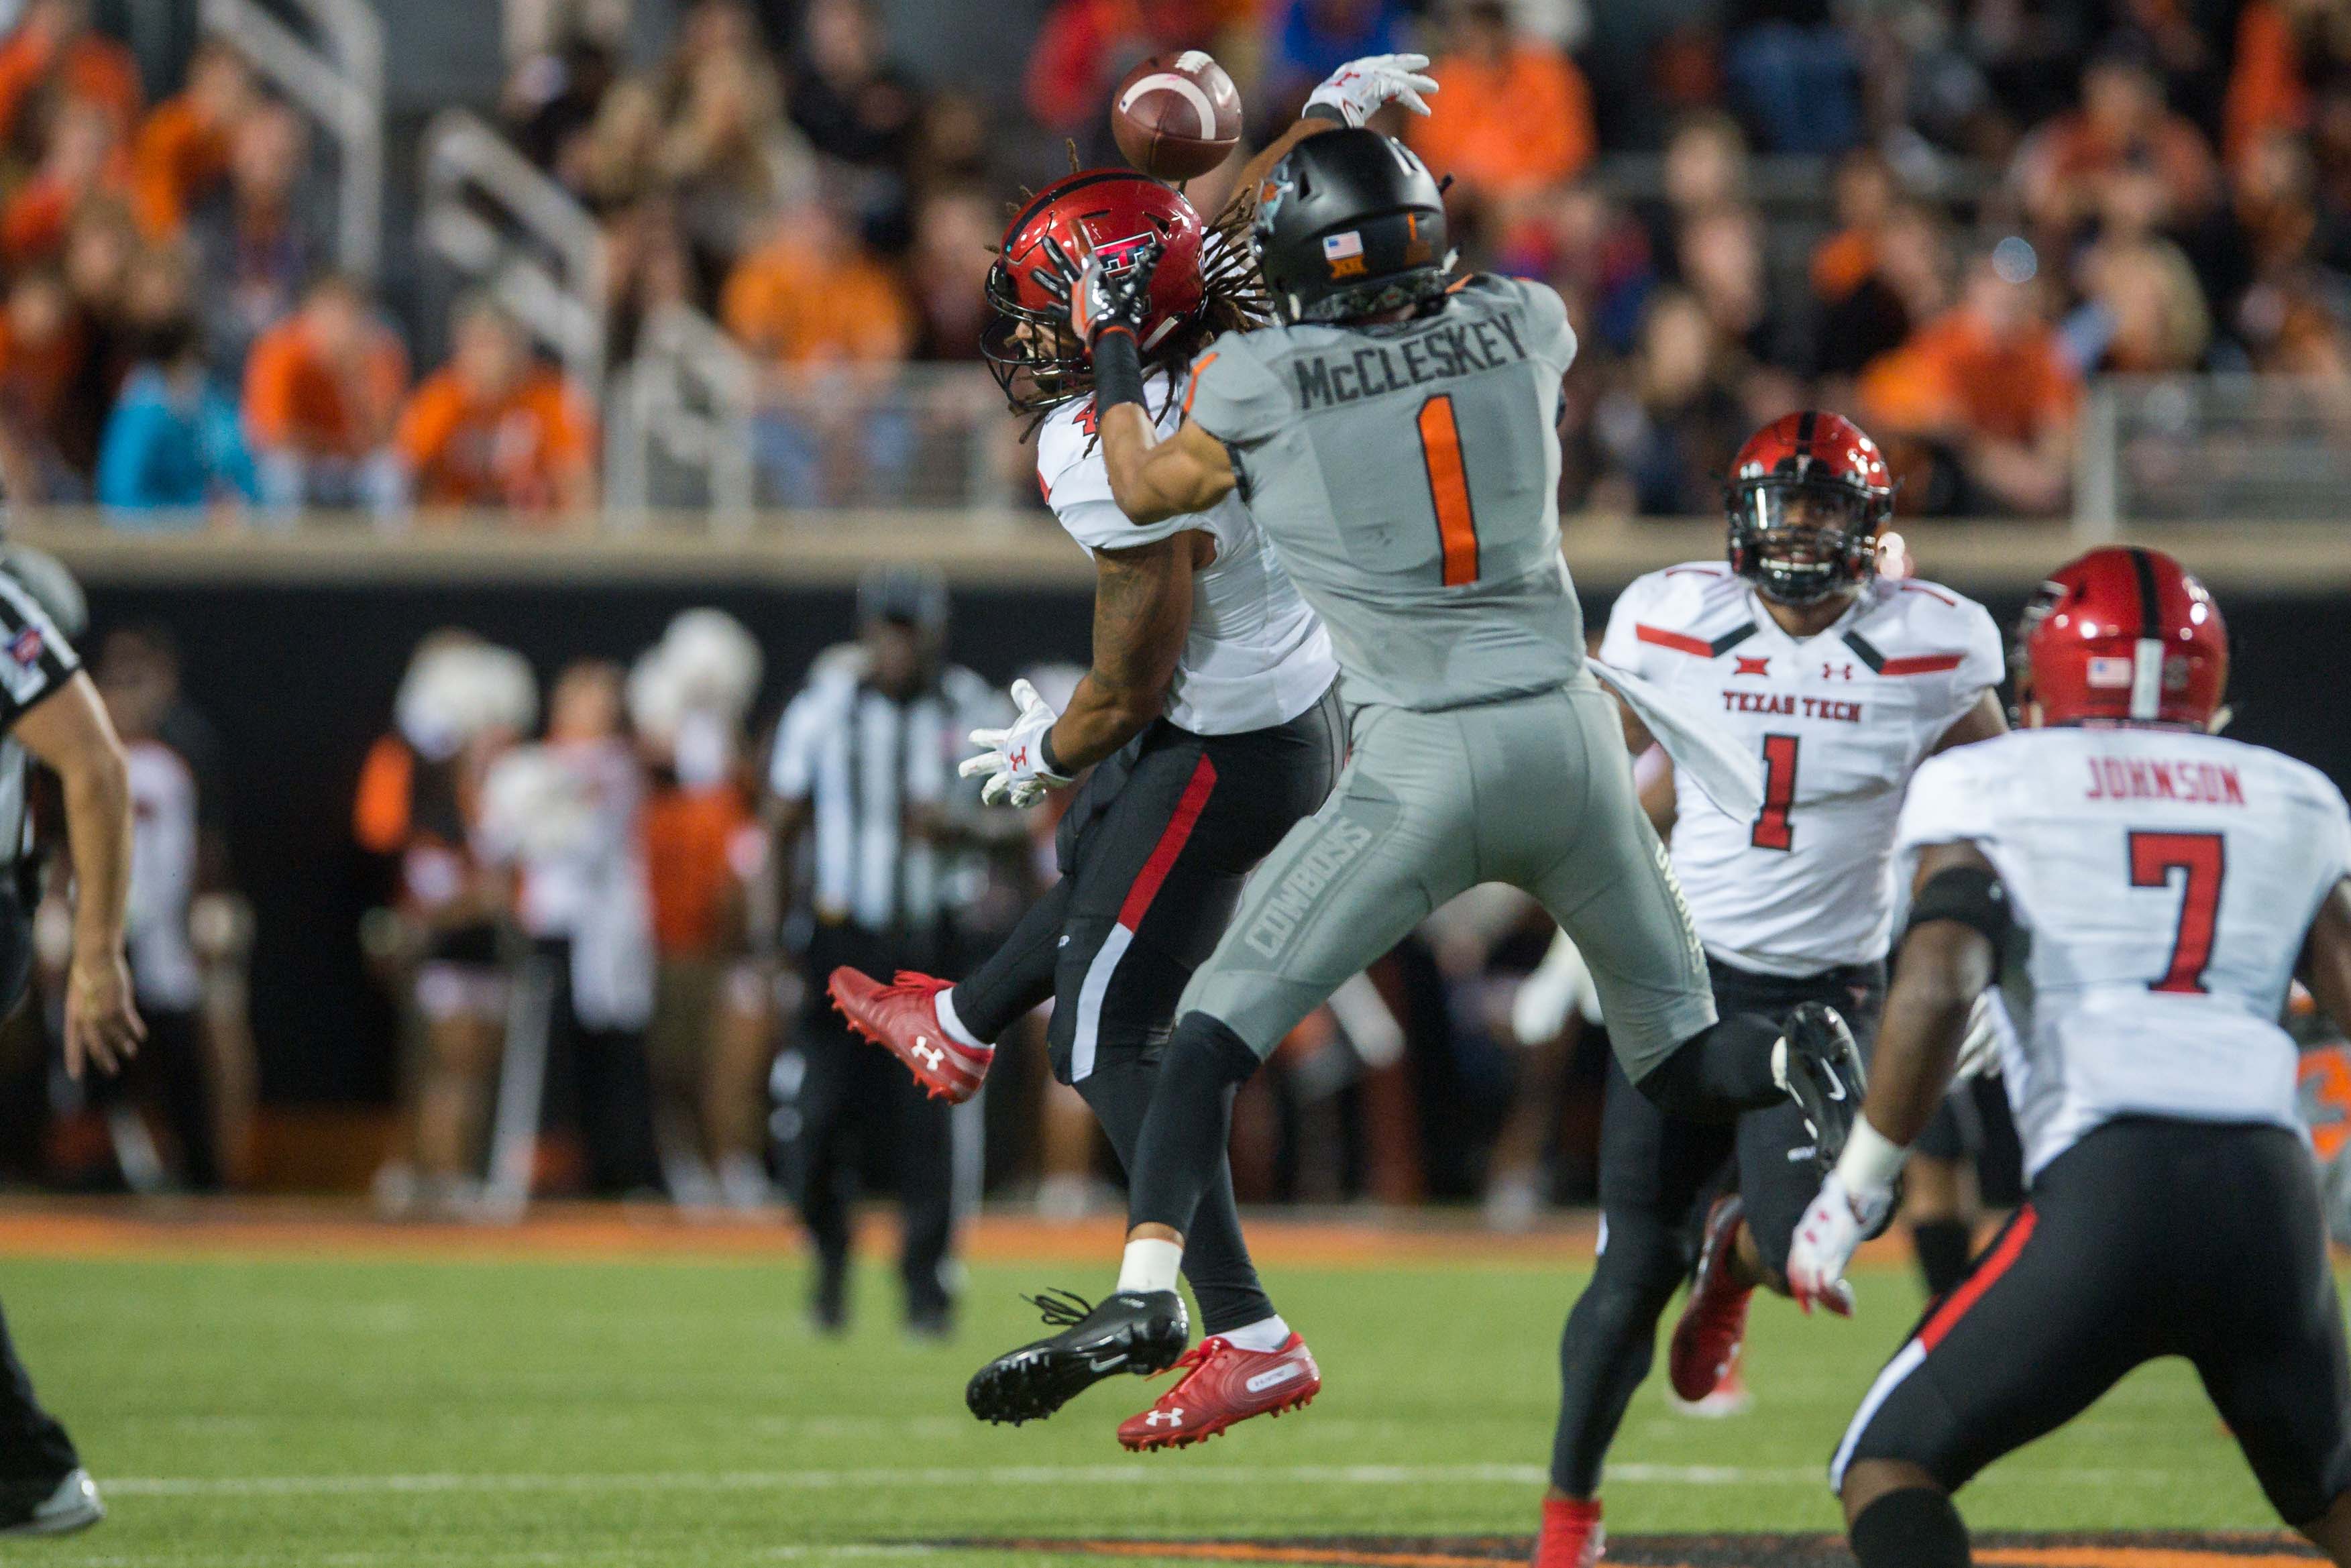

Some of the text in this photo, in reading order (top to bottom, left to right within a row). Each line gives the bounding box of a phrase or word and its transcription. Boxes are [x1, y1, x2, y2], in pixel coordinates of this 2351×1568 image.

[1294, 312, 1528, 410] McCLESKEY
[1415, 392, 1480, 587] 1
[1723, 689, 1862, 722] TEXAS TECH
[1752, 733, 1800, 852] 1
[2085, 756, 2248, 806] JOHNSON
[1245, 816, 1373, 959] COWBOYS
[2127, 830, 2227, 994] 7
